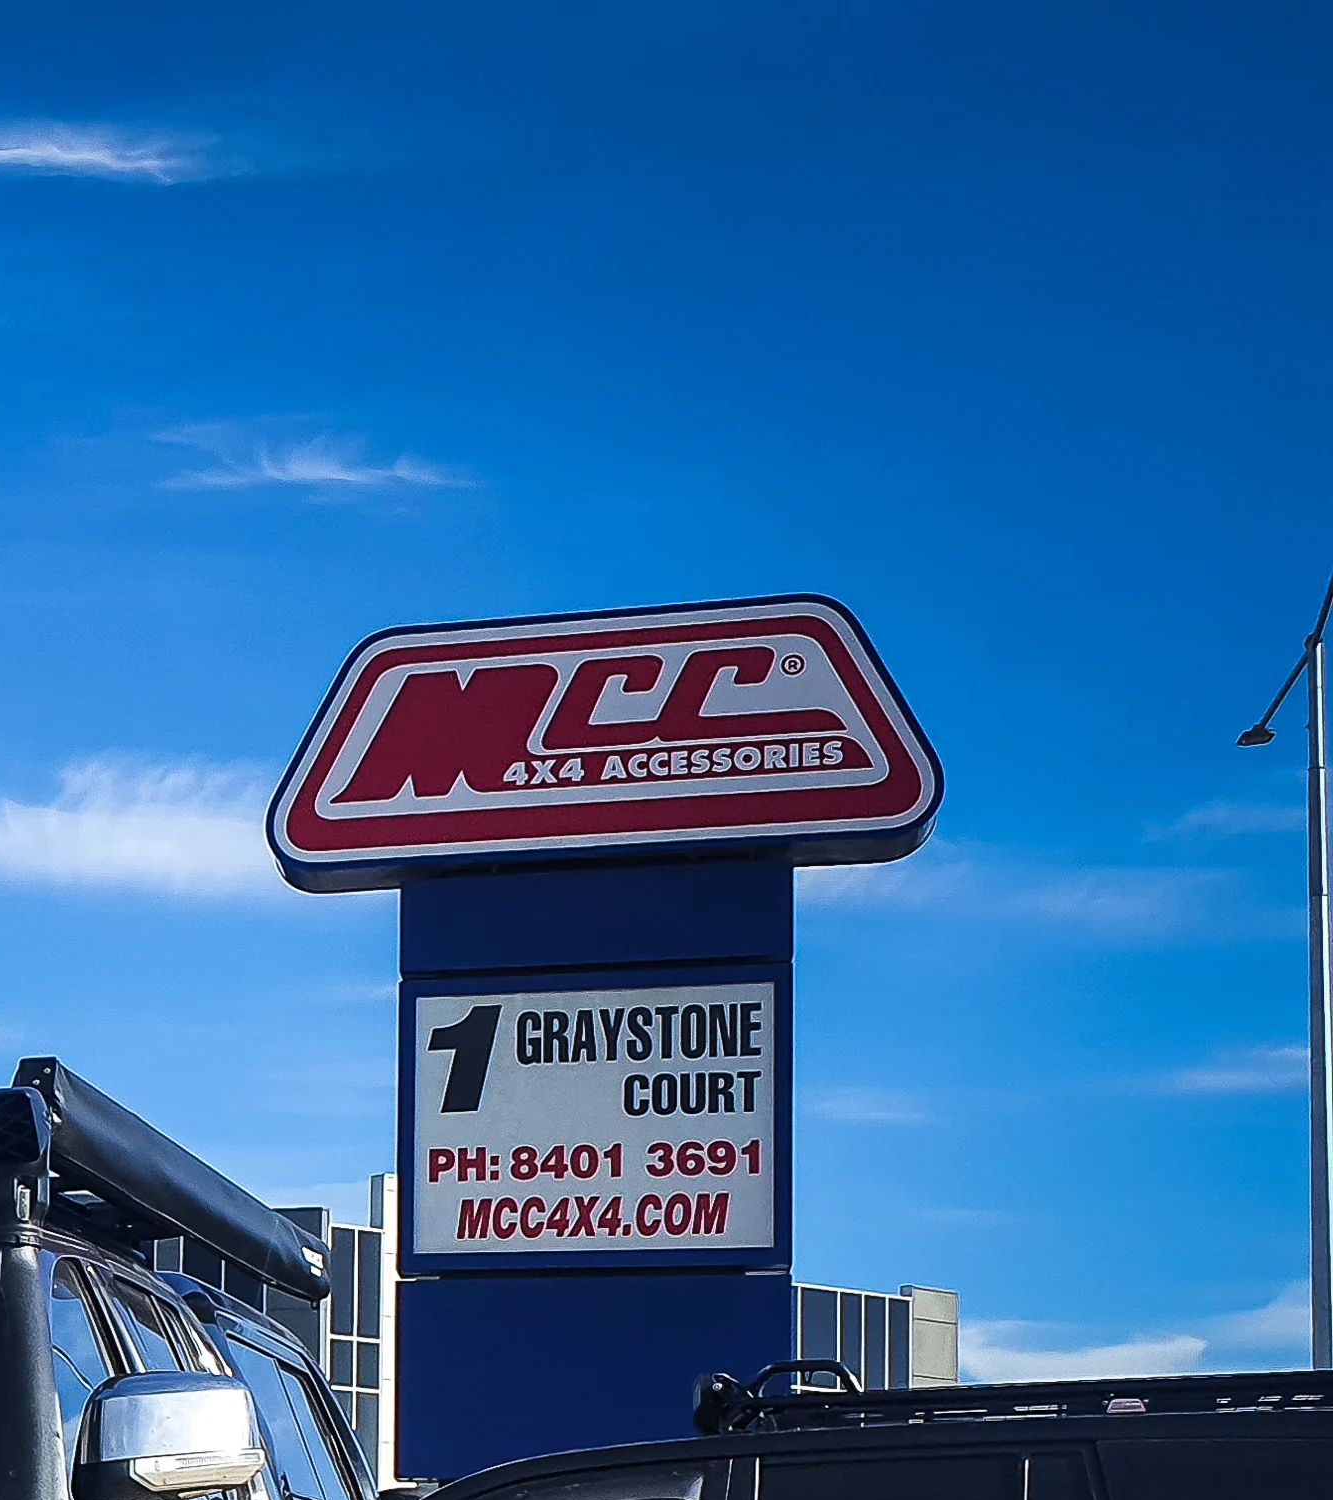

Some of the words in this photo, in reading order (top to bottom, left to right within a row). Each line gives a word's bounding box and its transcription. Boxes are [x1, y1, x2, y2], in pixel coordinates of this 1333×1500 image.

[328, 645, 848, 805] MCC
[503, 757, 585, 786] 4X4
[600, 740, 845, 780] ACCESSORIES
[428, 1004, 503, 1114] 1
[516, 1002, 763, 1066] GRAYSTONE
[623, 1070, 762, 1116] COURT
[429, 1147, 501, 1183] PH:
[510, 1143, 623, 1180] 8401
[646, 1138, 762, 1177] 3691
[457, 1192, 731, 1240] MCC4X4.COM
